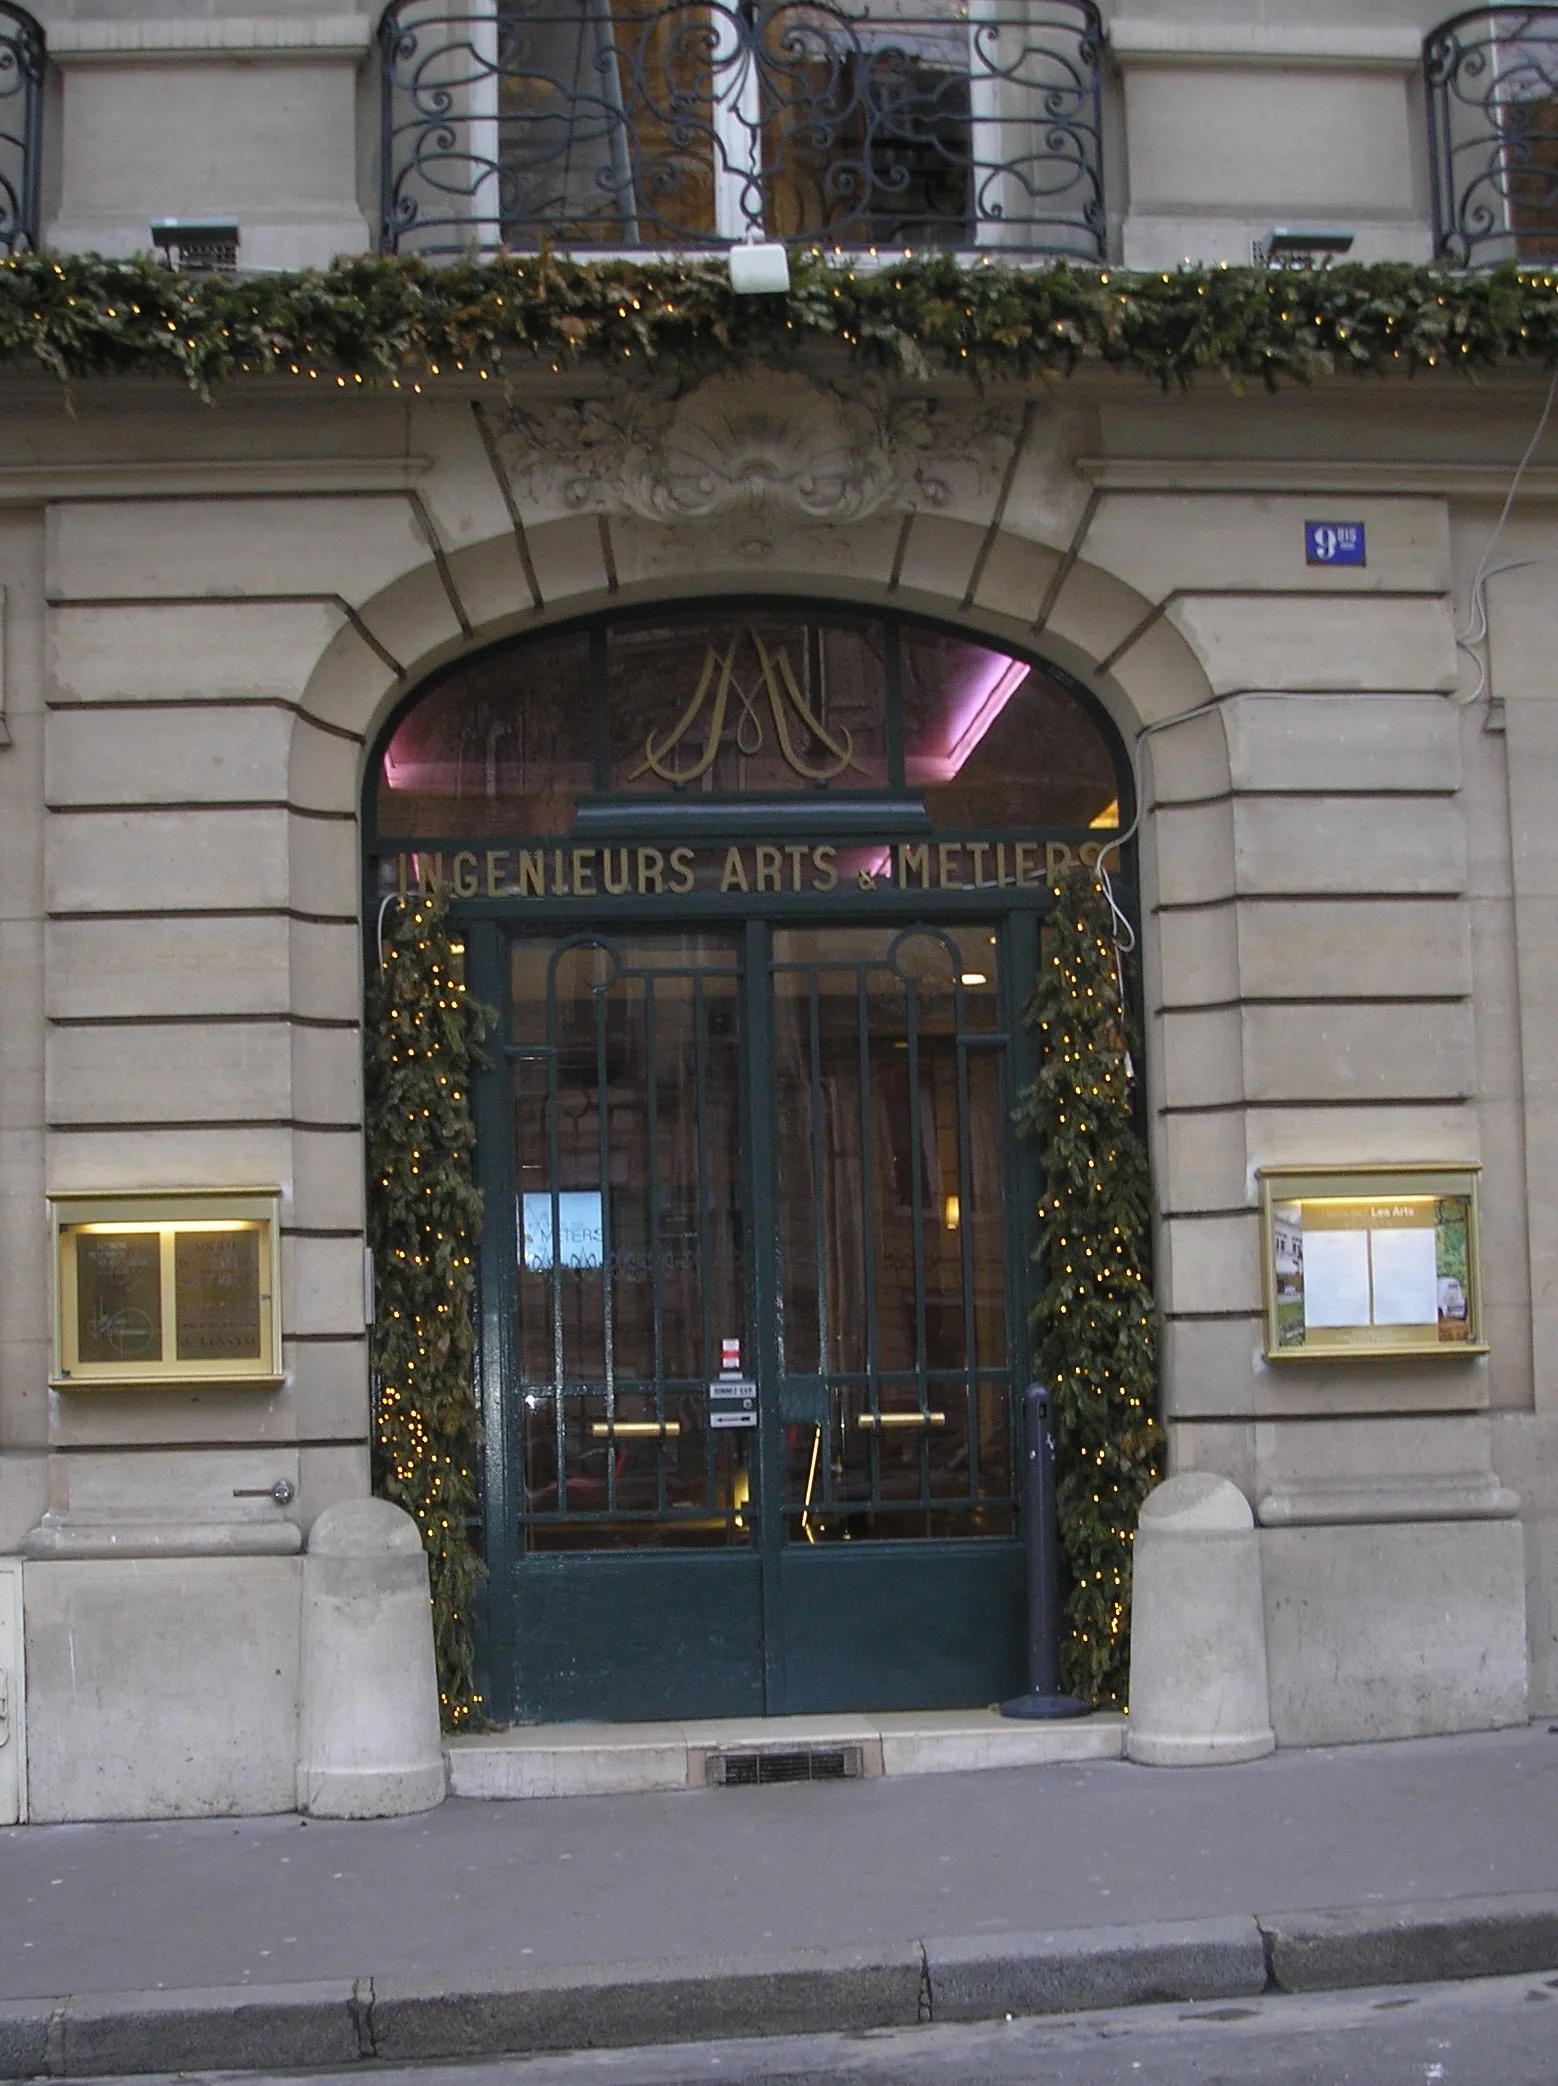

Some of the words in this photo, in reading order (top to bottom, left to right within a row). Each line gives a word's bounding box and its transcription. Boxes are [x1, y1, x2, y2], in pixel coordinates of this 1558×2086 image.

[396, 846, 696, 898] INGENIEURS
[720, 844, 838, 892] ARTS
[857, 869, 878, 892] &
[1392, 1205, 1415, 1218] Arts
